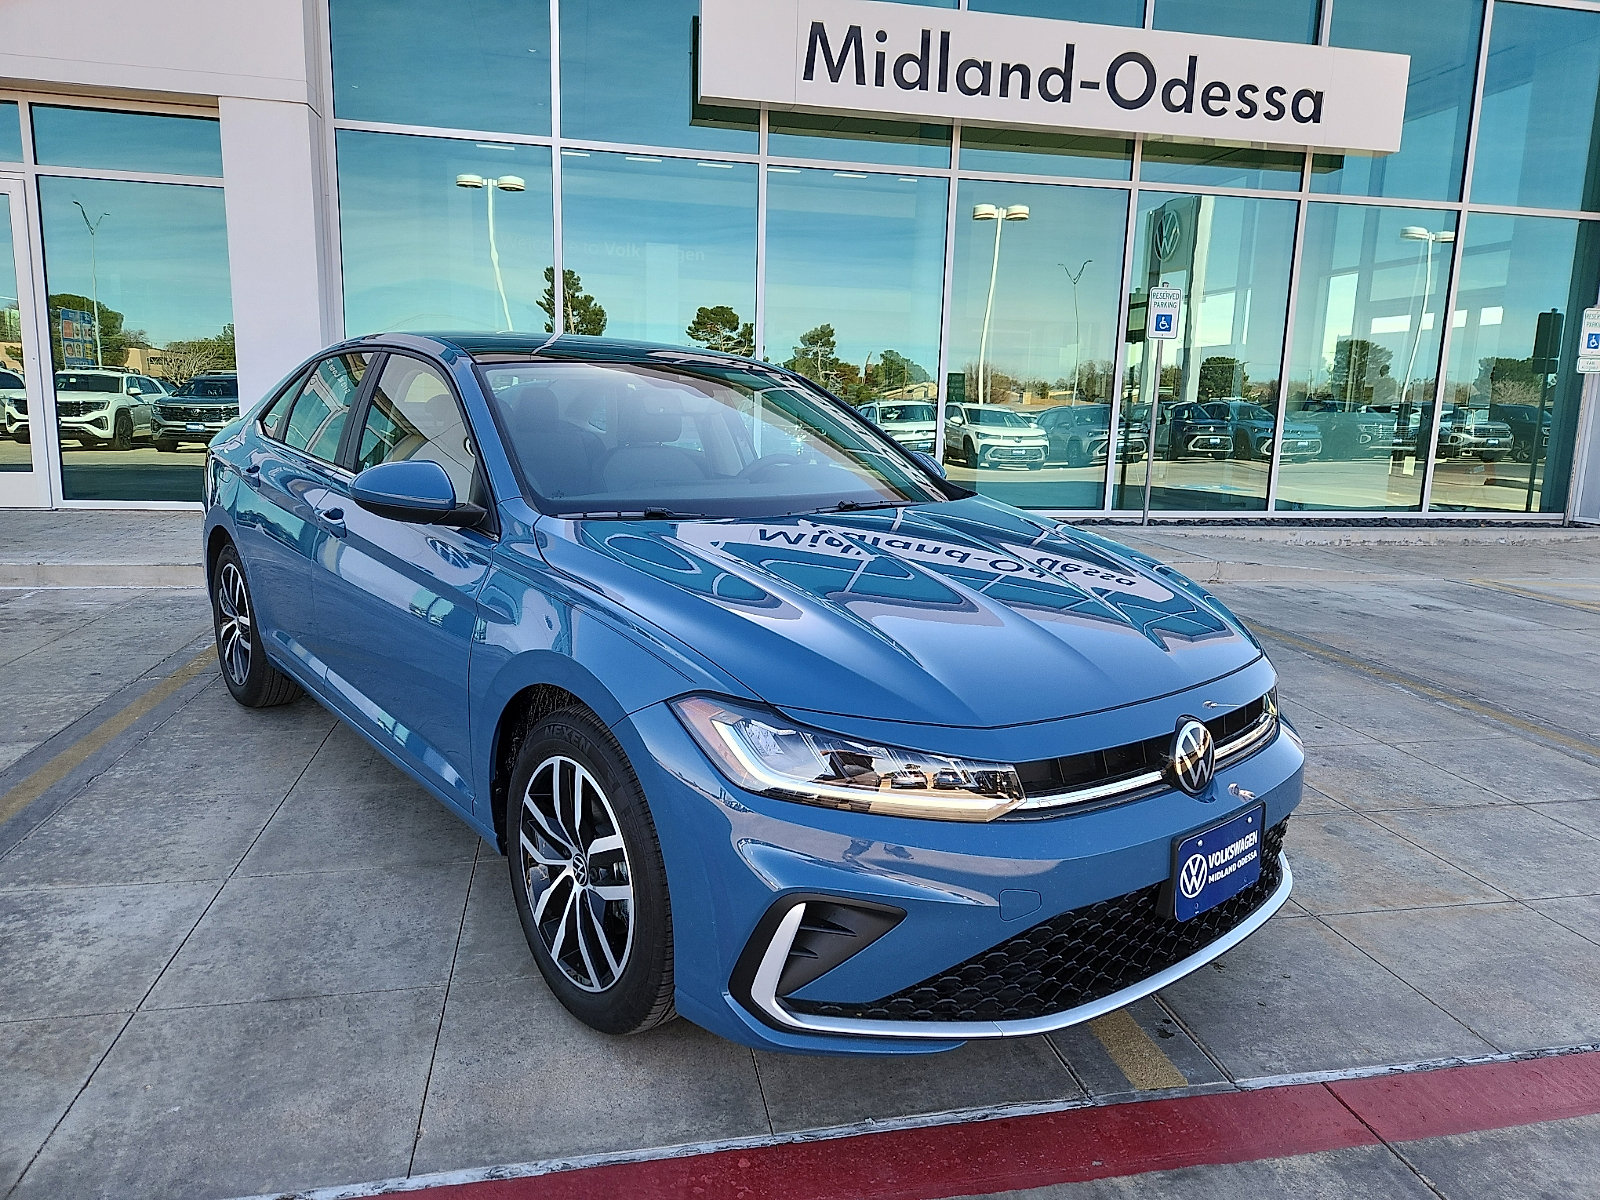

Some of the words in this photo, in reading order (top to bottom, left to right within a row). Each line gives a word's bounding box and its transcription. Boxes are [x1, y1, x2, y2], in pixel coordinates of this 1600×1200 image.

[803, 20, 1325, 124] Midland-Odessa
[1153, 292, 1179, 300] RESERVED
[1153, 301, 1177, 309] PARKING
[544, 725, 591, 753] NEXEN
[1208, 830, 1258, 869] VOLKSWAGEN
[1208, 862, 1237, 884] MIDLAND
[1236, 850, 1258, 868] ODESSA
